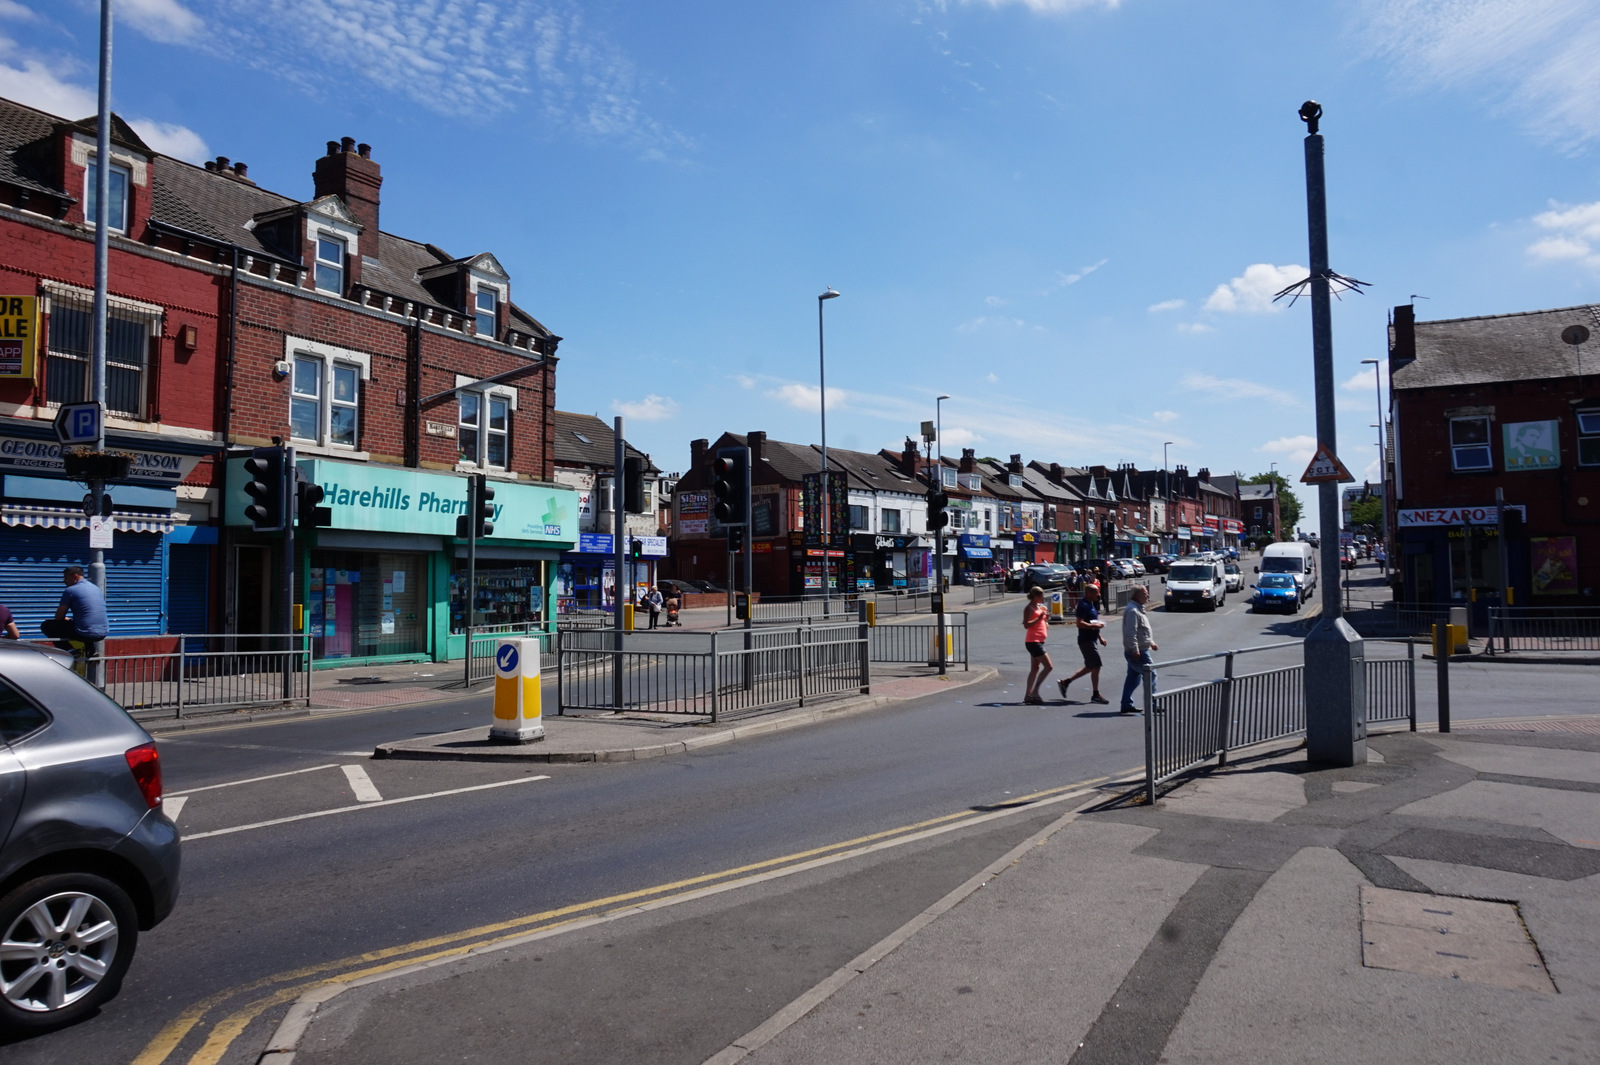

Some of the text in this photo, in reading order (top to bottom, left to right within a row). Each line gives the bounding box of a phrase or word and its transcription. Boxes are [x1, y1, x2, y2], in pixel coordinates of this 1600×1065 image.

[0, 297, 23, 316] OR
[78, 413, 92, 435] P
[13, 457, 66, 469] ENGLISH
[1508, 455, 1557, 465] NEZARO
[1308, 465, 1339, 474] CCTV
[84, 500, 94, 511] 20
[323, 482, 503, 522] Harehills Pharmy
[1414, 509, 1485, 524] NEZARO
[545, 525, 560, 535] NHS
